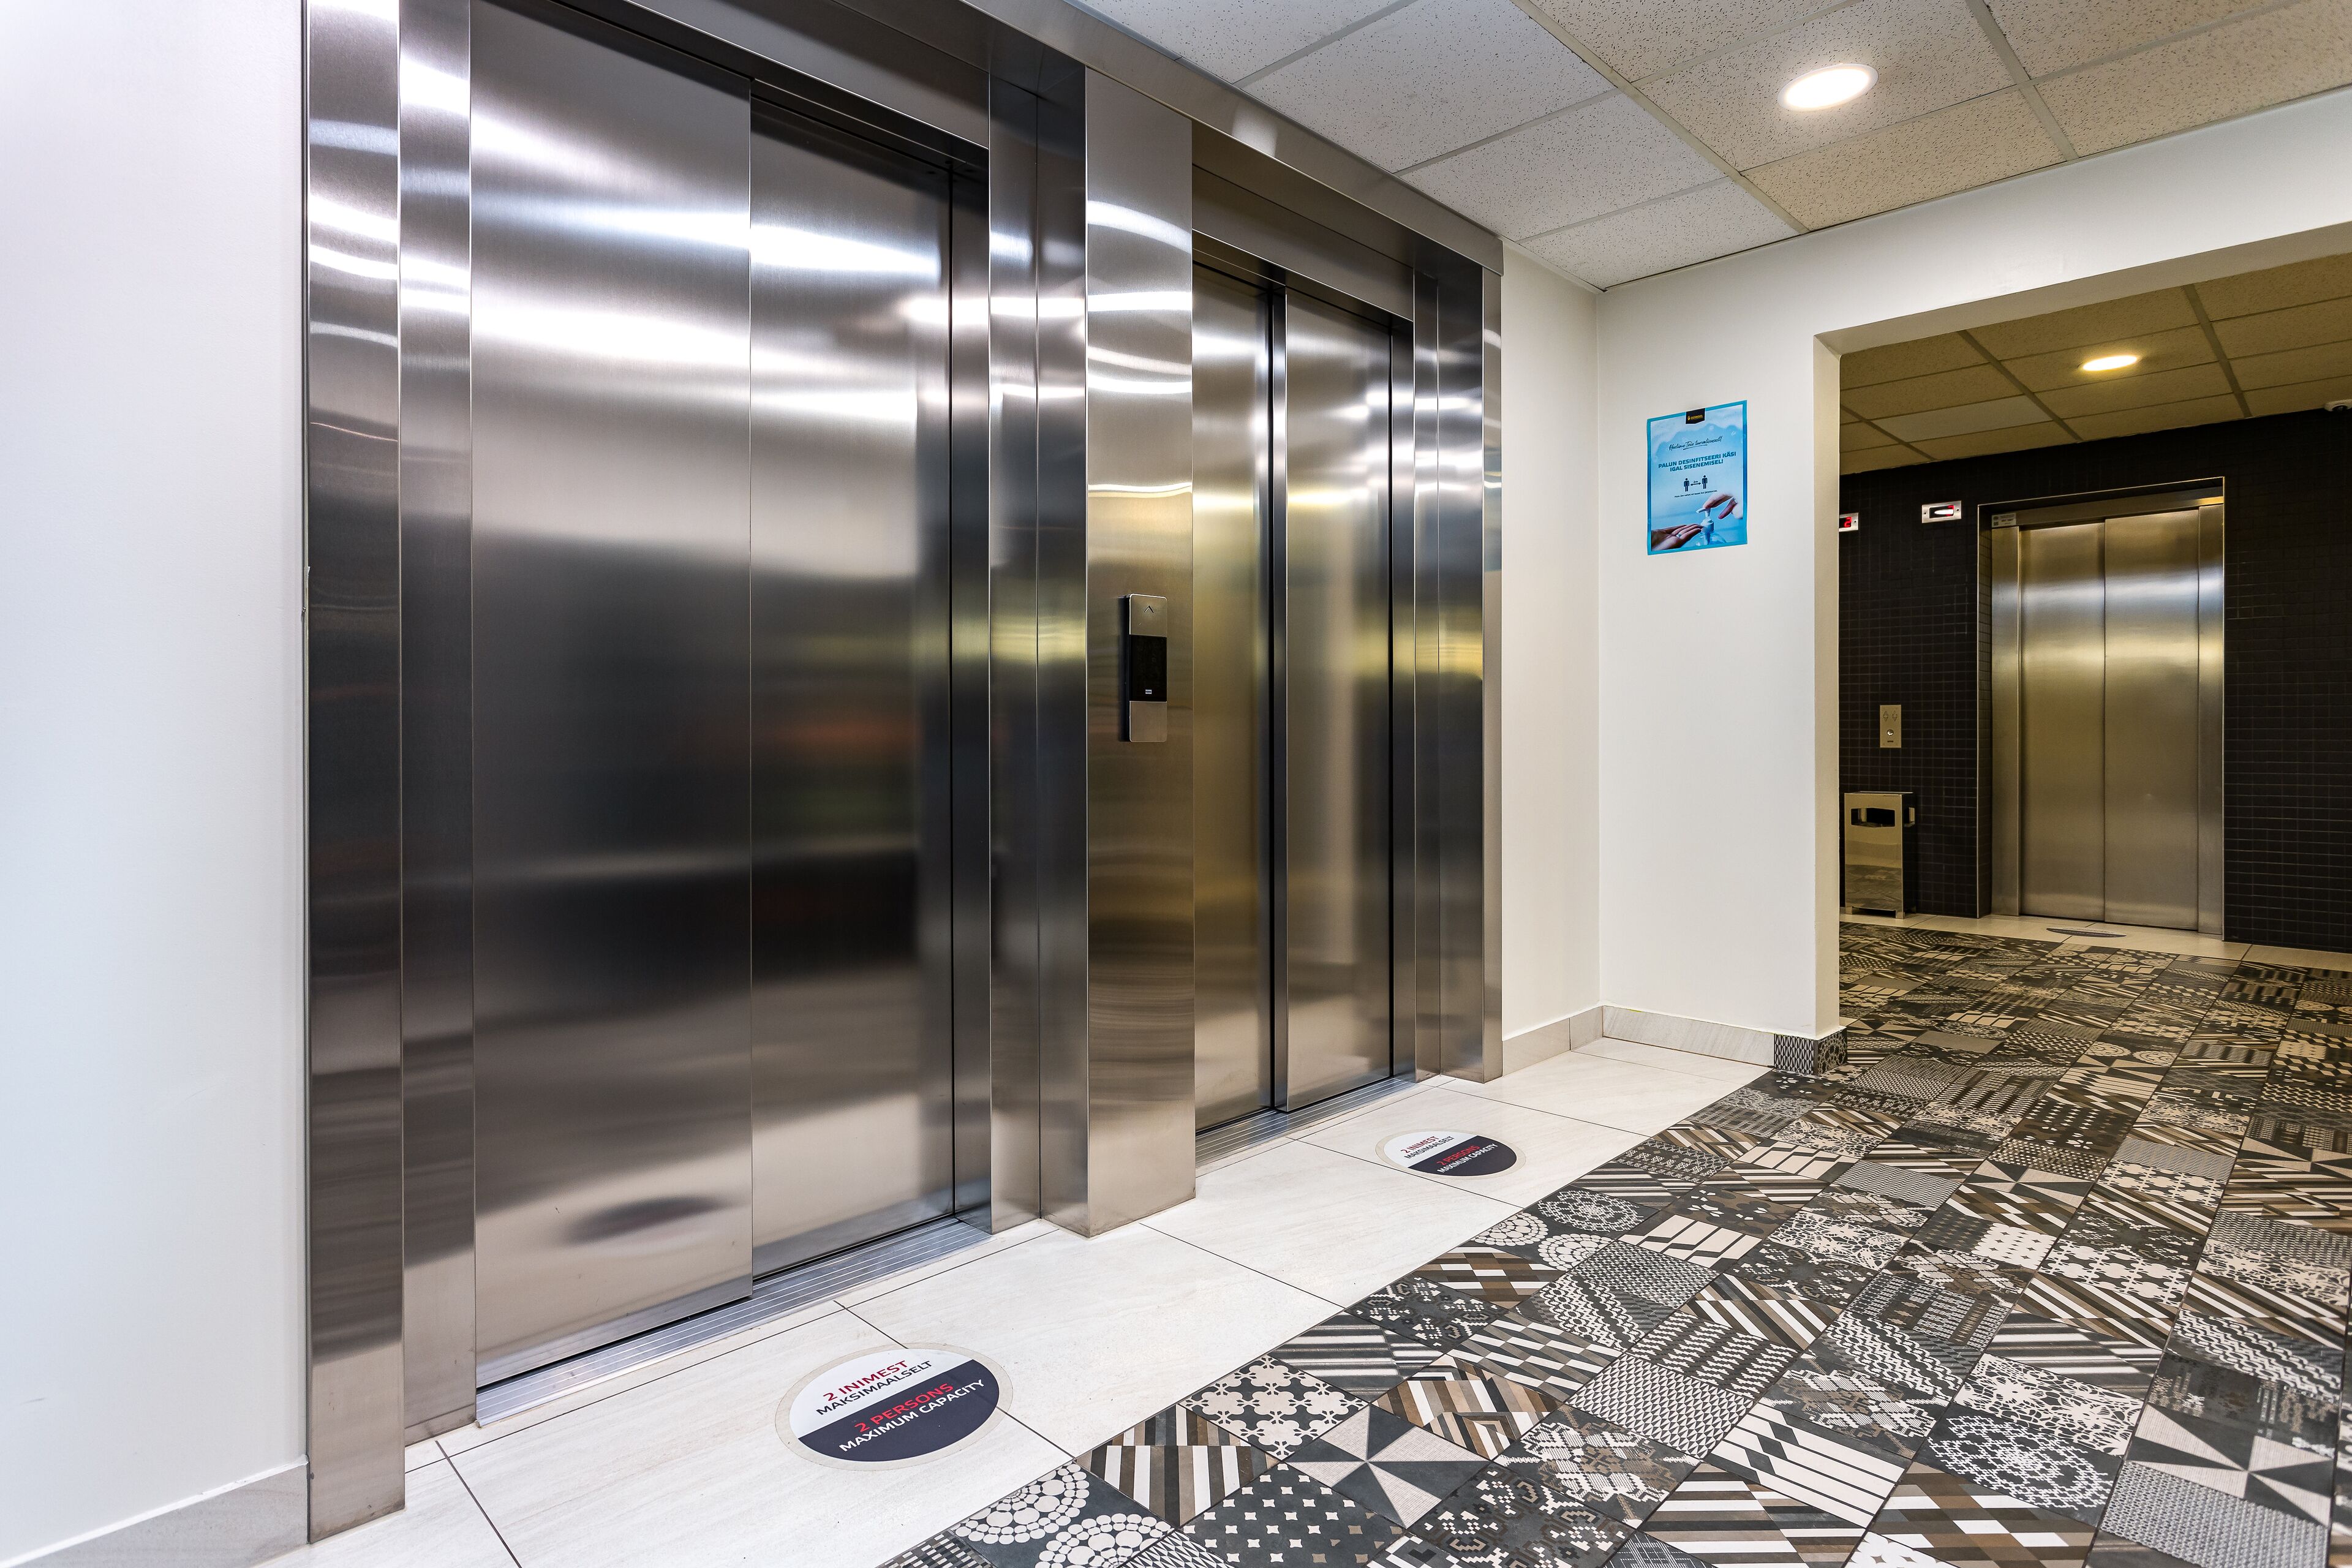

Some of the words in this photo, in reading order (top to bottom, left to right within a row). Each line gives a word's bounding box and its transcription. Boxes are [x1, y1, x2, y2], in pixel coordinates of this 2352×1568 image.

[1678, 454, 1721, 465] DESINFITSEERI
[1684, 459, 1724, 470] SISENEMISEL!
[1404, 1136, 1455, 1159] MAKSIMAALSELT
[1408, 1136, 1439, 1150] INIMEST
[1442, 1145, 1480, 1163] PERSONS
[1437, 1157, 1471, 1173] MAXIMUM
[1469, 1143, 1498, 1159] CAPACITY
[816, 1360, 932, 1415] MAKSIMAALSELT
[823, 1392, 838, 1401] 2
[839, 1360, 908, 1393] INIMEST
[839, 1411, 919, 1452] MAXIMUM
[919, 1379, 985, 1414] CAPACITY
[854, 1422, 871, 1432] 2
[869, 1383, 954, 1425] PERSONS
